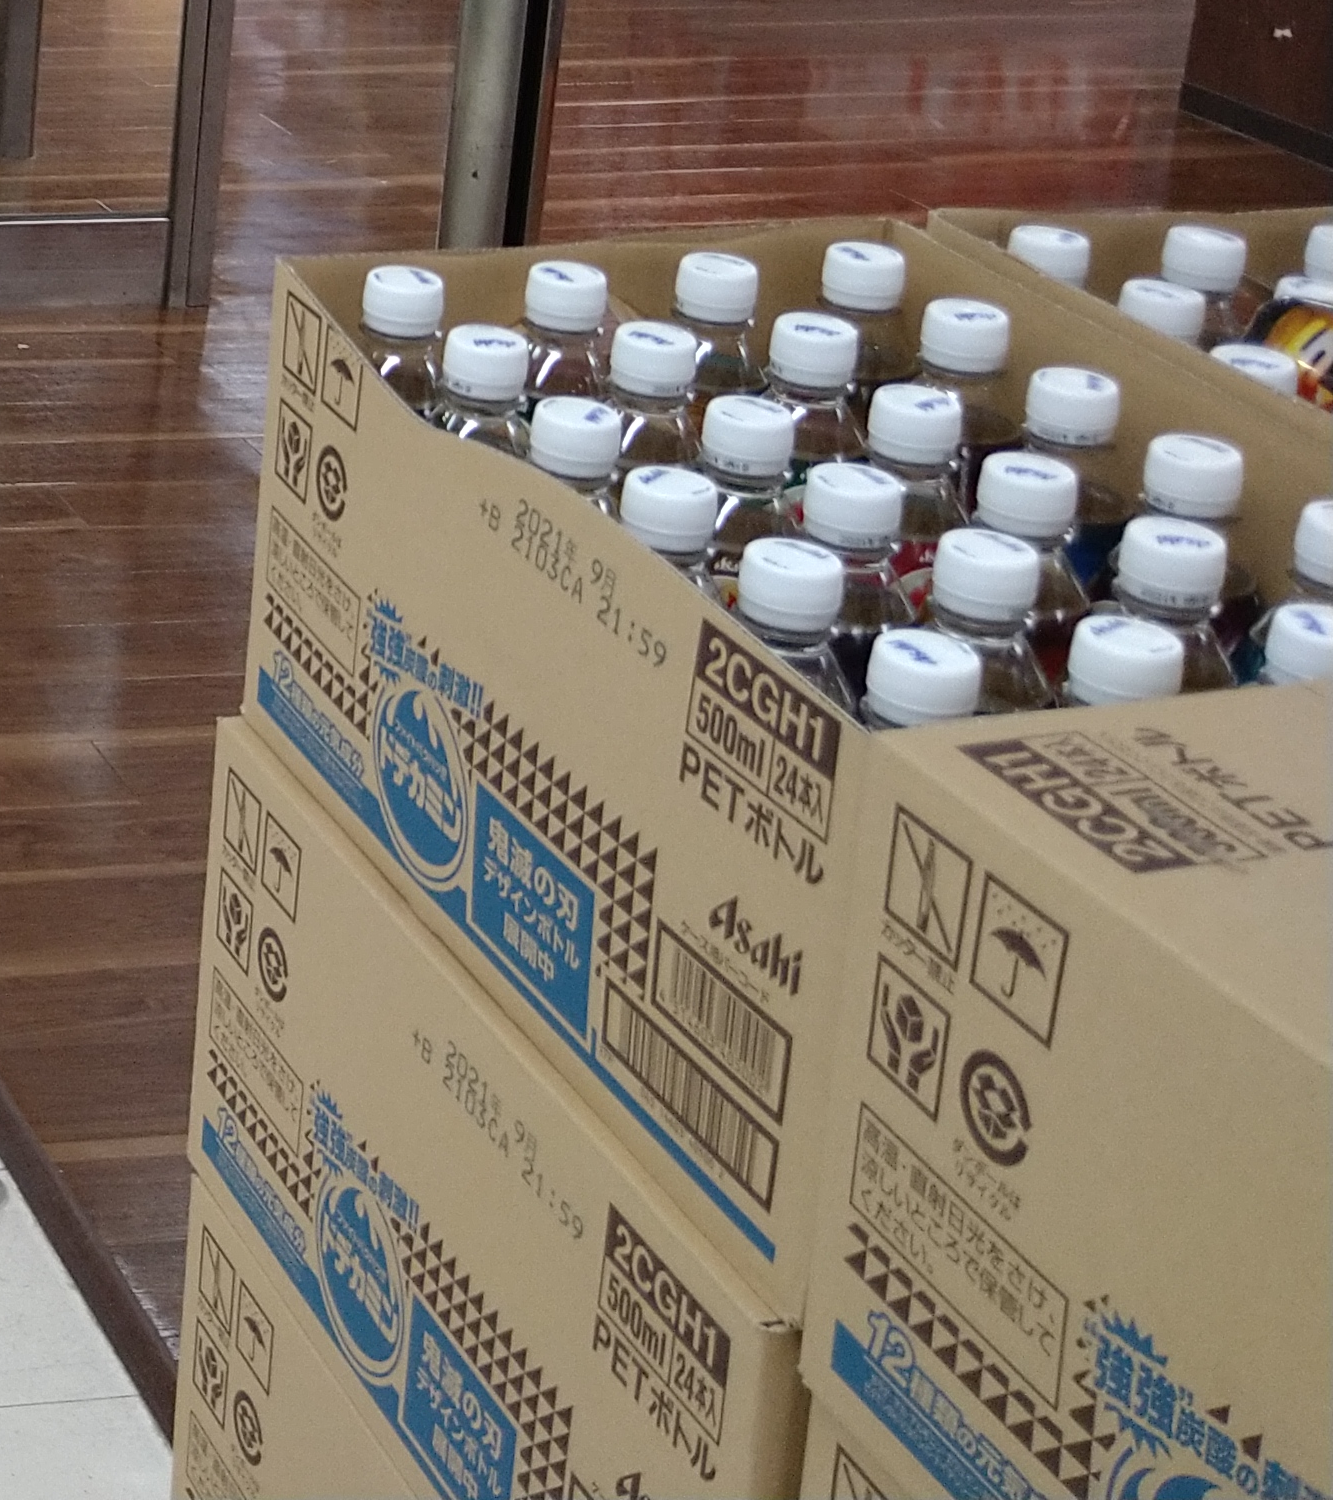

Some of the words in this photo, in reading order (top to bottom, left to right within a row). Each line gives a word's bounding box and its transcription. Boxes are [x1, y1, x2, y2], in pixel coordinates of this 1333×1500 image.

[510, 525, 584, 605] 2103CA
[595, 595, 669, 669] 21:59
[695, 692, 766, 780] 500ml
[772, 755, 825, 825] 24本入
[704, 636, 826, 763] 2CGH1
[679, 741, 825, 886] PETボトル
[983, 749, 1182, 865] 2CGH1
[482, 855, 580, 971] デザインボトル
[487, 816, 580, 933] 鬼滅の刃
[502, 912, 555, 983] 展開中
[708, 895, 804, 997] Asahi
[520, 1165, 585, 1240] 21:59
[606, 1271, 667, 1368] 500ml
[674, 1353, 718, 1428] 24本入
[615, 1223, 720, 1368] 2CGH1
[421, 1330, 503, 1462] 鬼滅の刃
[592, 1312, 717, 1483] PETボトル
